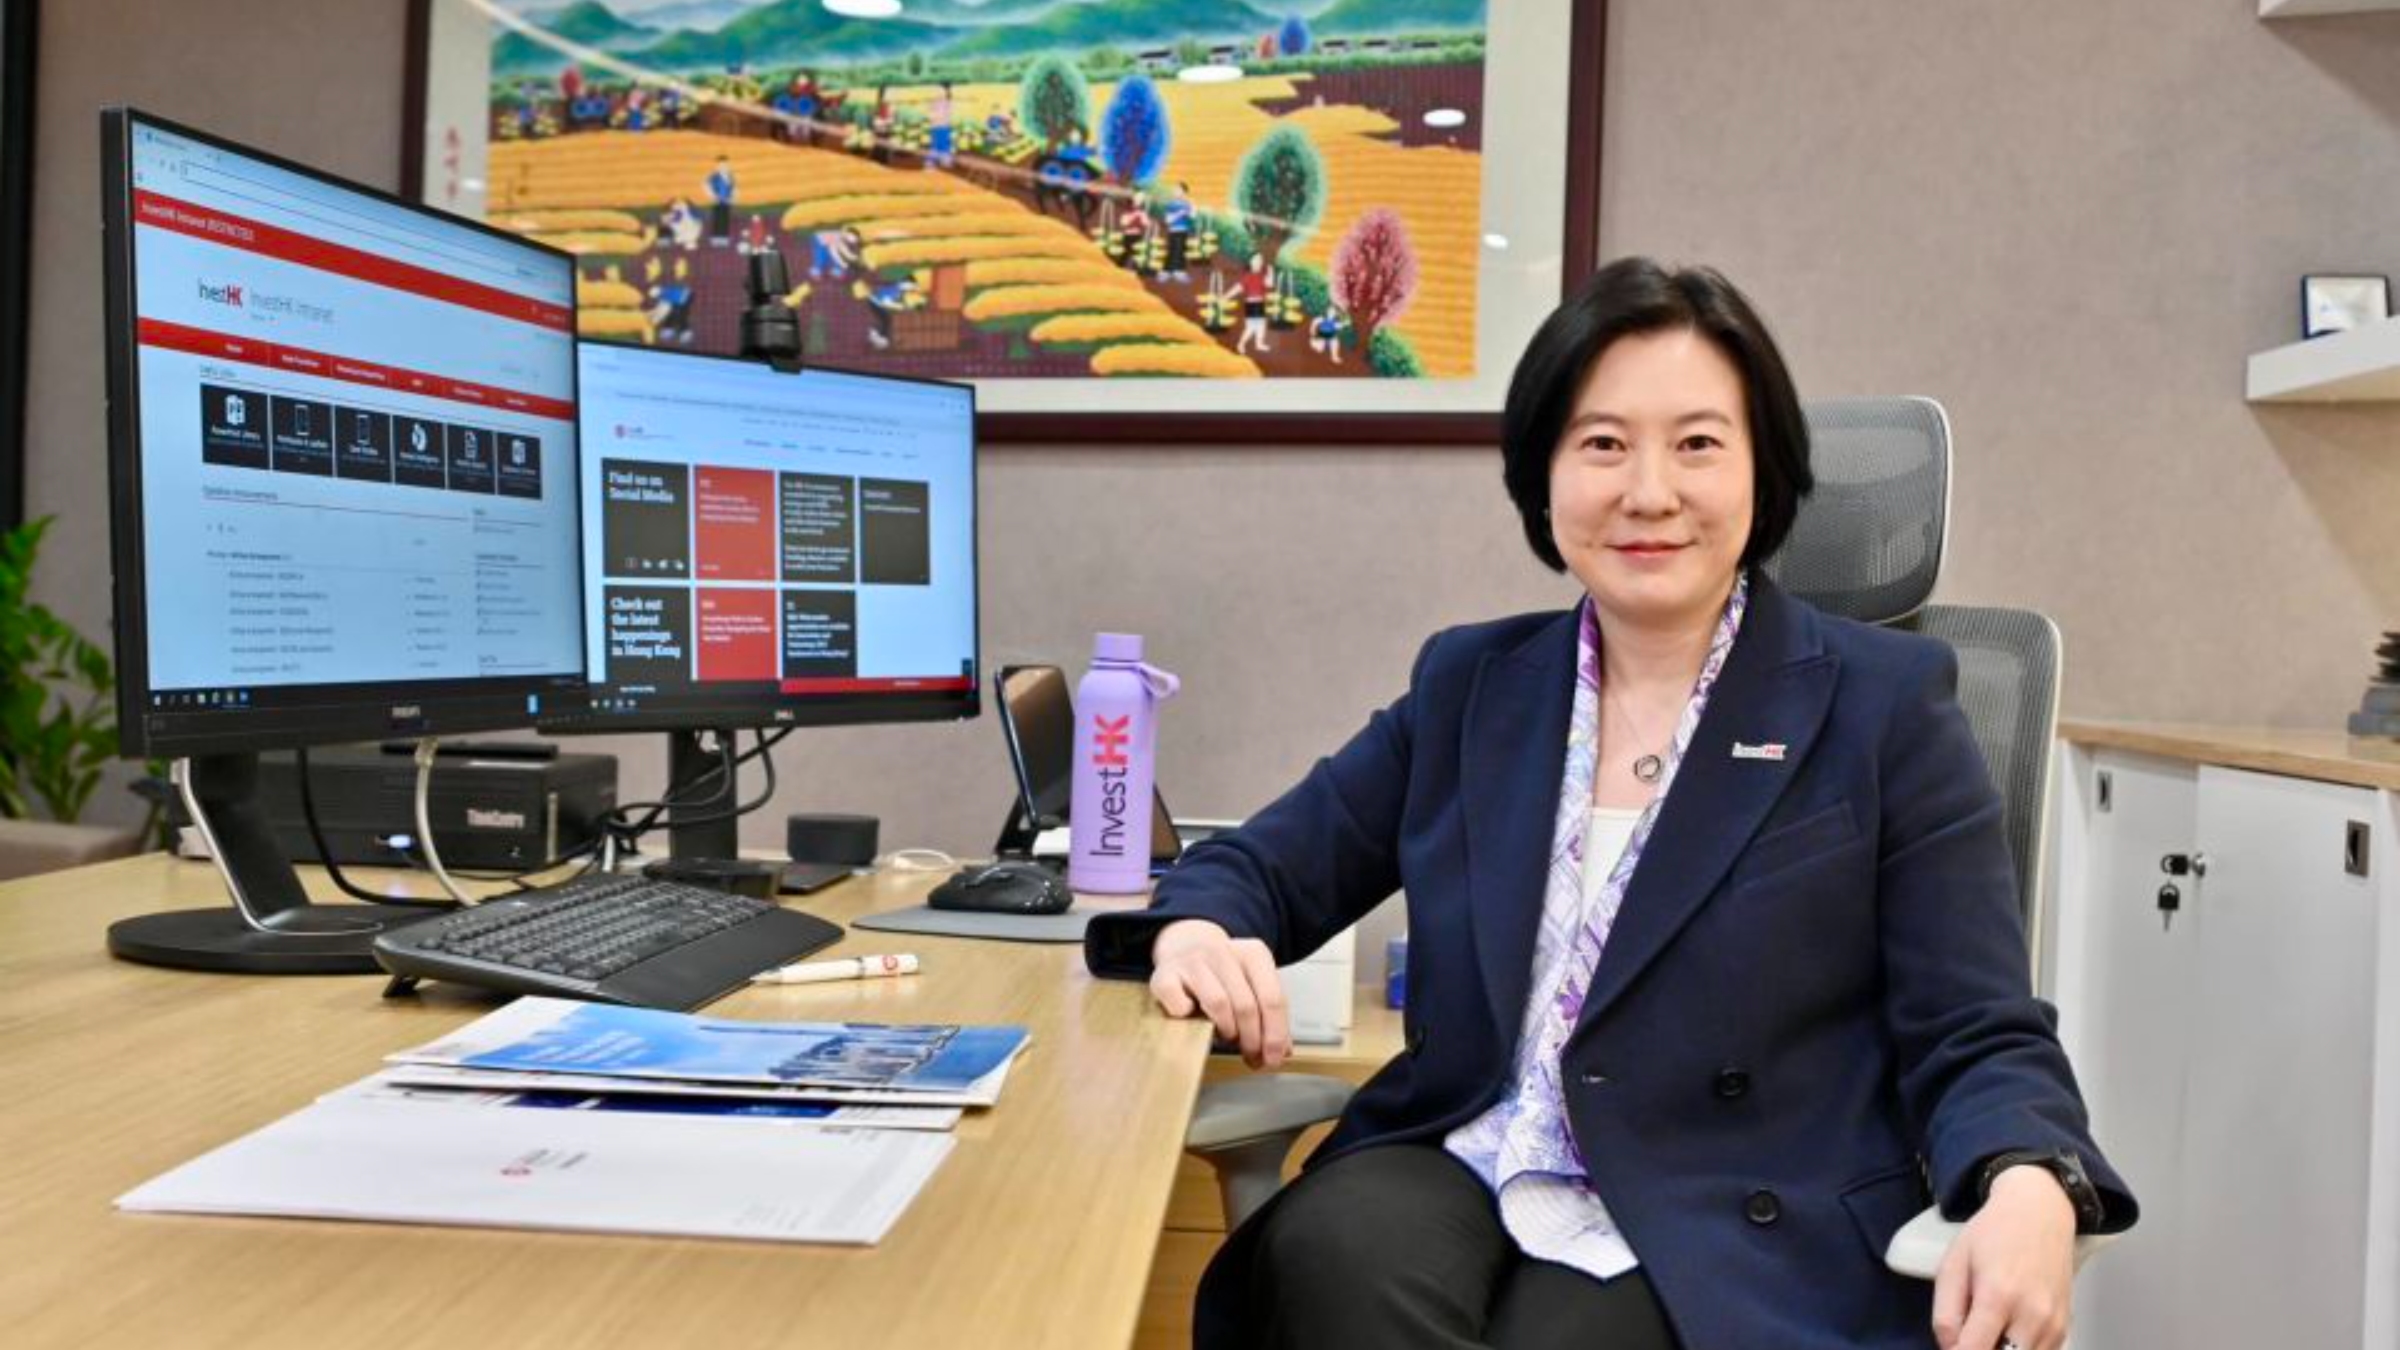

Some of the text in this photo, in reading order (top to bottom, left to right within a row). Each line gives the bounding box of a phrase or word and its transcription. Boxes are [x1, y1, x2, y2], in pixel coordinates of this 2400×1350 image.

[609, 471, 634, 485] Find
[635, 476, 648, 486] us
[609, 486, 674, 503] Social Media
[612, 597, 663, 611] Check out
[612, 612, 660, 626] the latest
[612, 627, 671, 643] happenings
[612, 643, 681, 659] in Hong Kong
[1089, 714, 1131, 858] InvestHK
